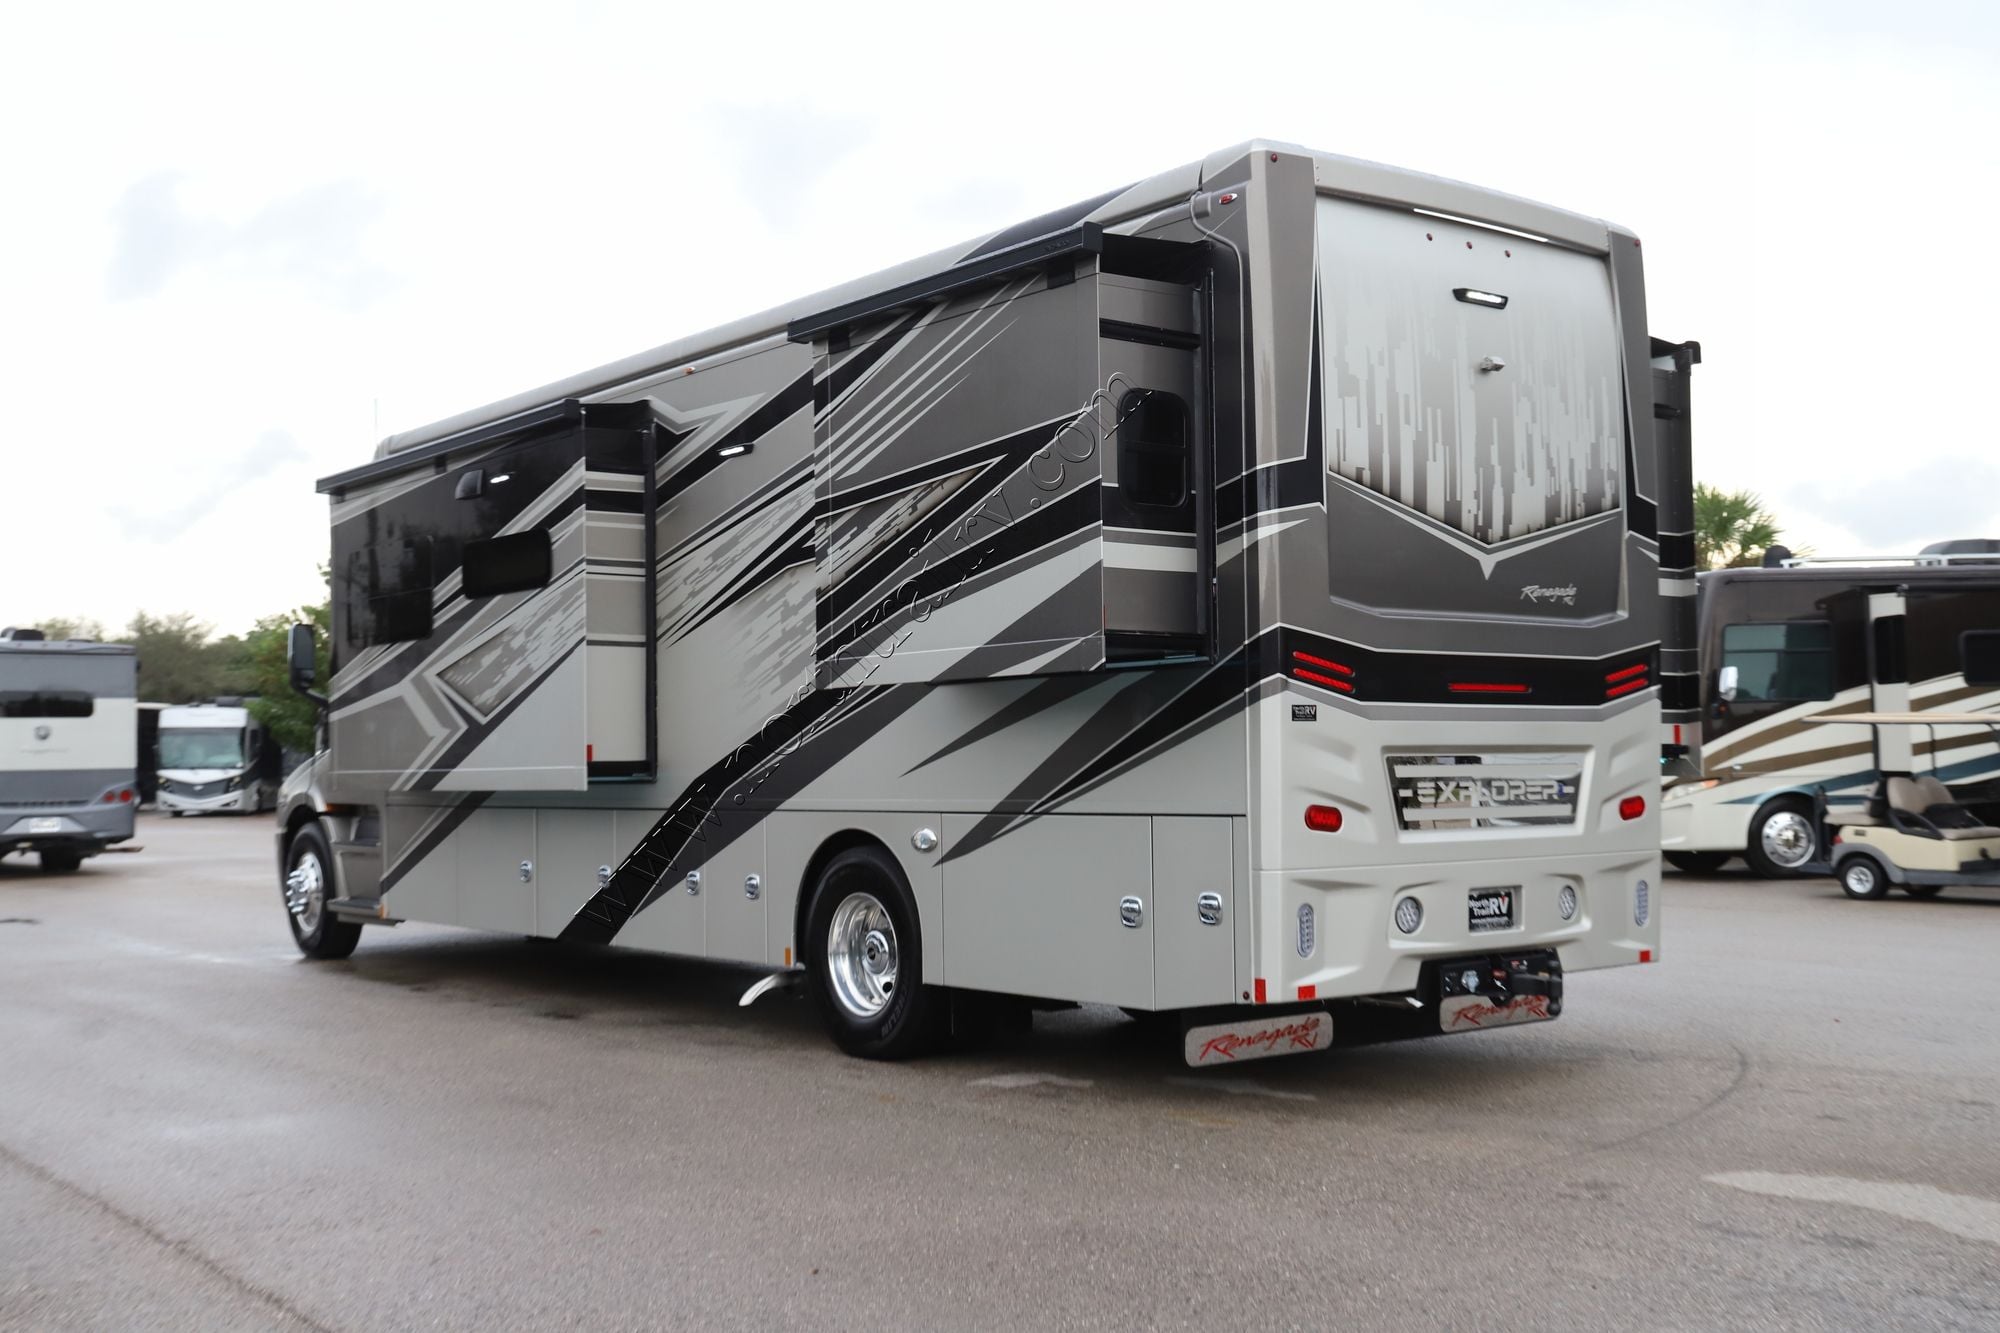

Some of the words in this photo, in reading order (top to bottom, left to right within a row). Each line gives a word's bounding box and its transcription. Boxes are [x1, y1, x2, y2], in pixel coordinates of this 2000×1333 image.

[1520, 583, 1577, 603] Renegade
[1416, 779, 1560, 804] EXPLORER
[1489, 895, 1509, 915] RV
[1199, 1016, 1320, 1061] Renegade
[1289, 1032, 1319, 1050] RV
